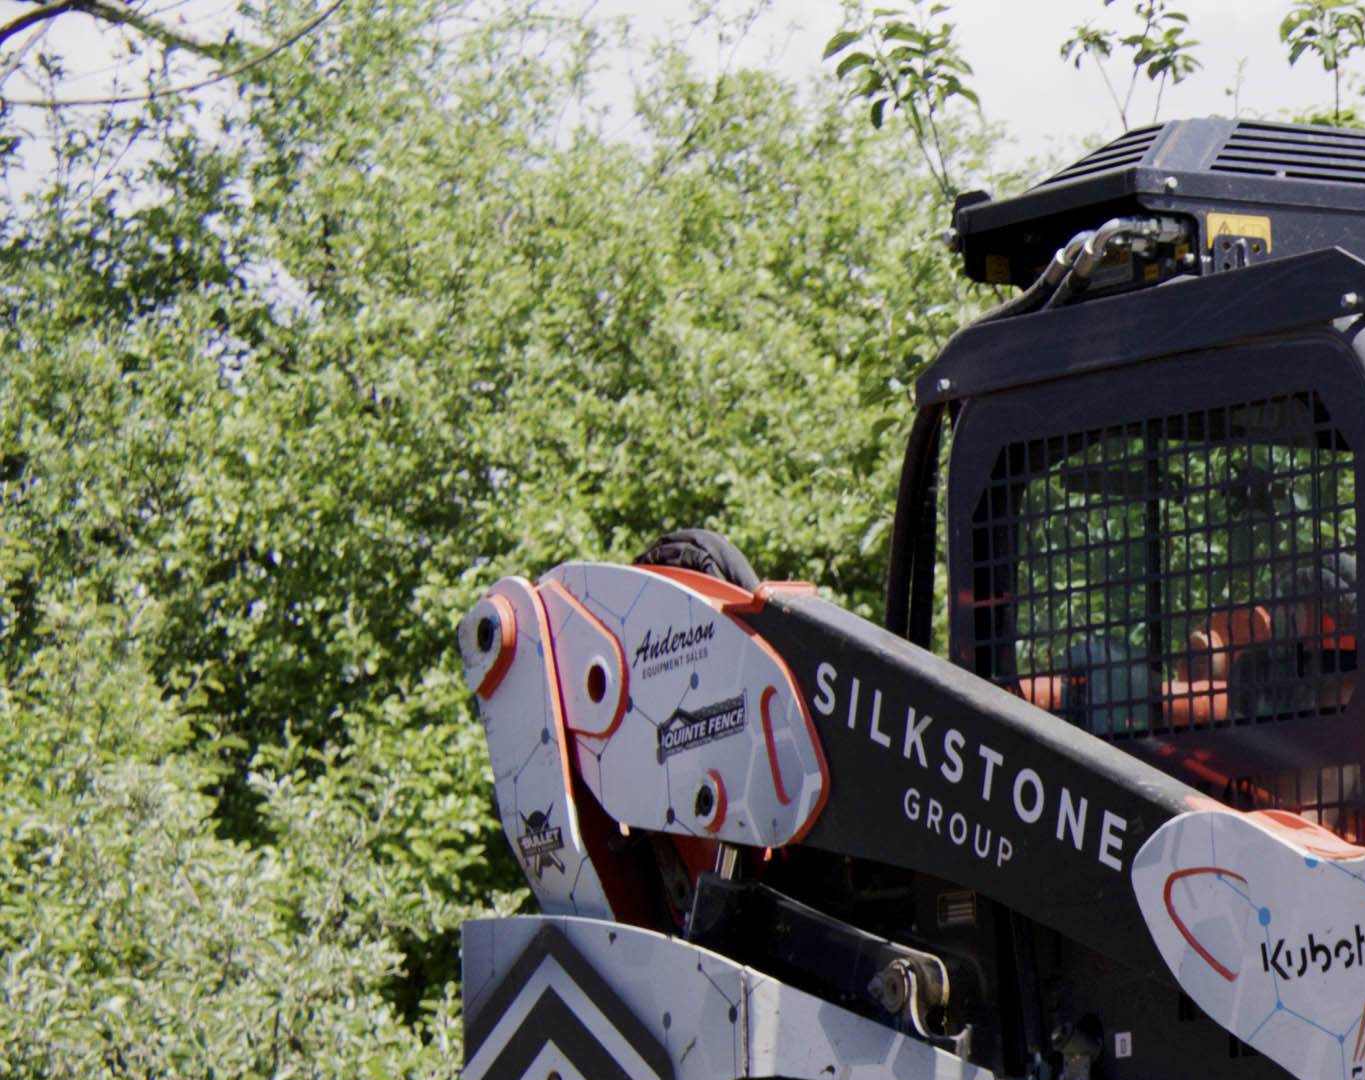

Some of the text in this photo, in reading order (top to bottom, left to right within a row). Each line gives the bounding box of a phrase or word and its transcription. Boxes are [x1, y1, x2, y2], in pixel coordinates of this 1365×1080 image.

[632, 621, 715, 669] Anderson
[642, 647, 708, 680] EQUIPMENT SALES
[663, 720, 707, 748] QUINTE
[708, 708, 744, 735] FENCE
[813, 661, 1127, 872] SILKSTONE
[520, 828, 560, 850] BULLET
[904, 788, 1013, 867] GROUP
